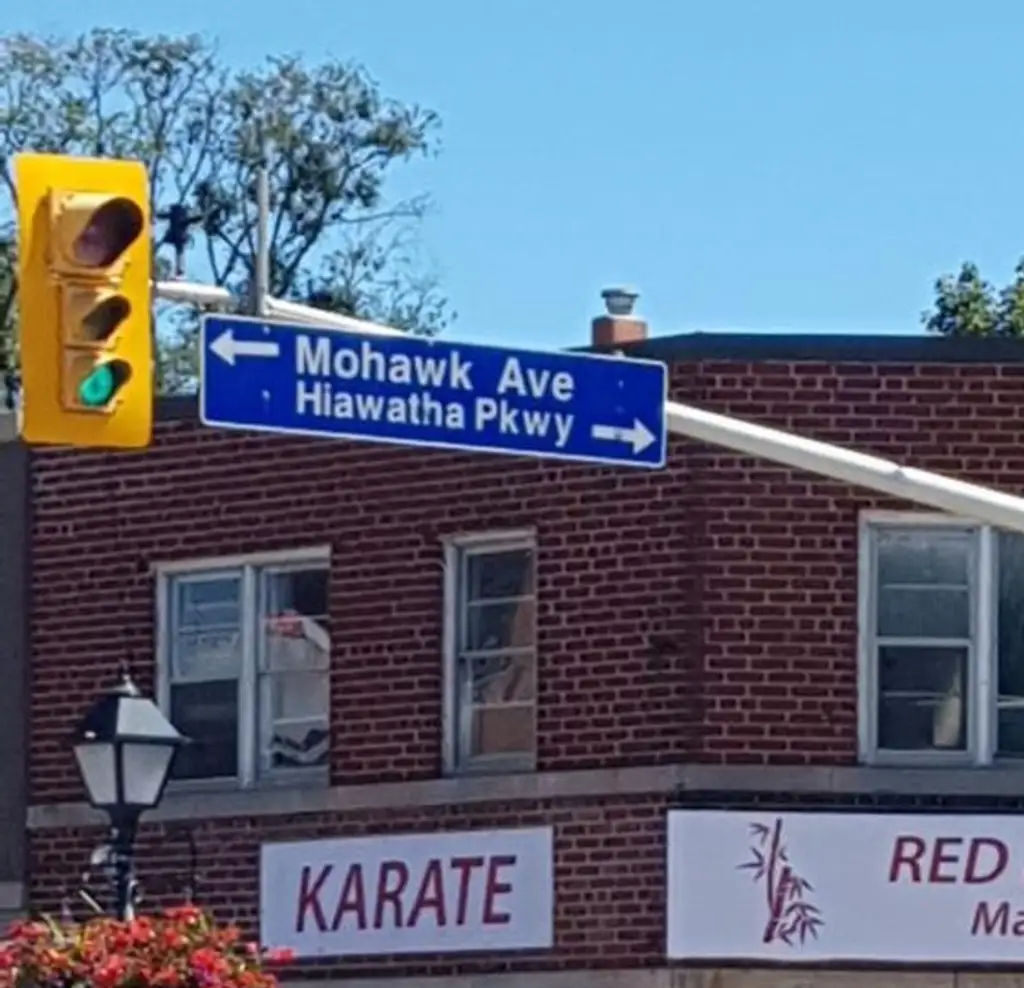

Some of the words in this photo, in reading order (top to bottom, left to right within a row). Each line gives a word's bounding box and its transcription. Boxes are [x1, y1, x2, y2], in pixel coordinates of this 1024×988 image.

[295, 334, 473, 392] Mohawk
[497, 357, 575, 401] Ave
[296, 380, 465, 430] Hiawatha
[475, 397, 575, 447] Pkwy
[295, 854, 517, 933] KARATE
[888, 836, 1008, 885] RED
